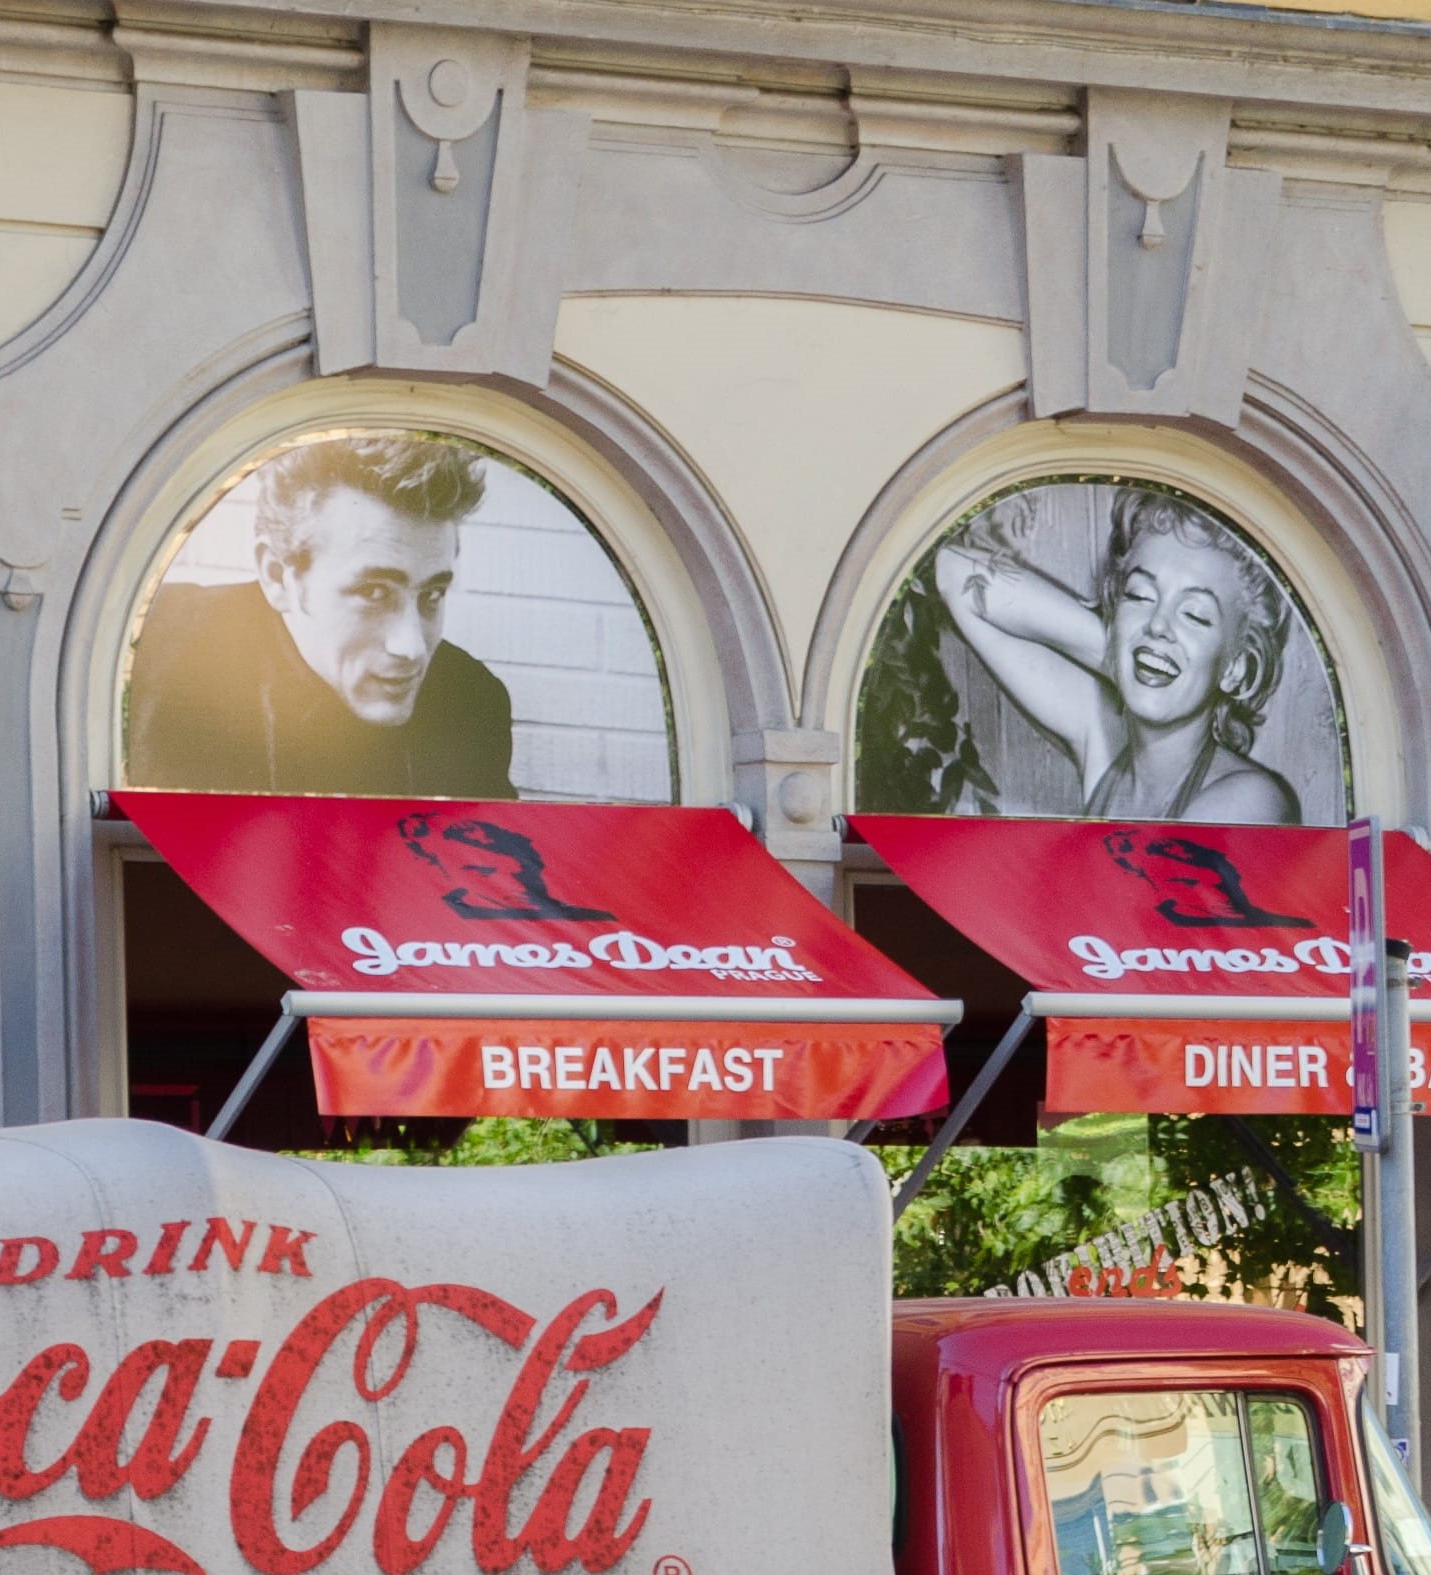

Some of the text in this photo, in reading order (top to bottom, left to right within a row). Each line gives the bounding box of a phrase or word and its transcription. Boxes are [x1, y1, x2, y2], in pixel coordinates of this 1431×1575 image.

[340, 926, 806, 977] James Dean
[1067, 935, 1300, 980] James
[711, 967, 823, 984] PRAGUE
[480, 1045, 784, 1094] BREAKFAST
[1183, 1044, 1329, 1089] DINER
